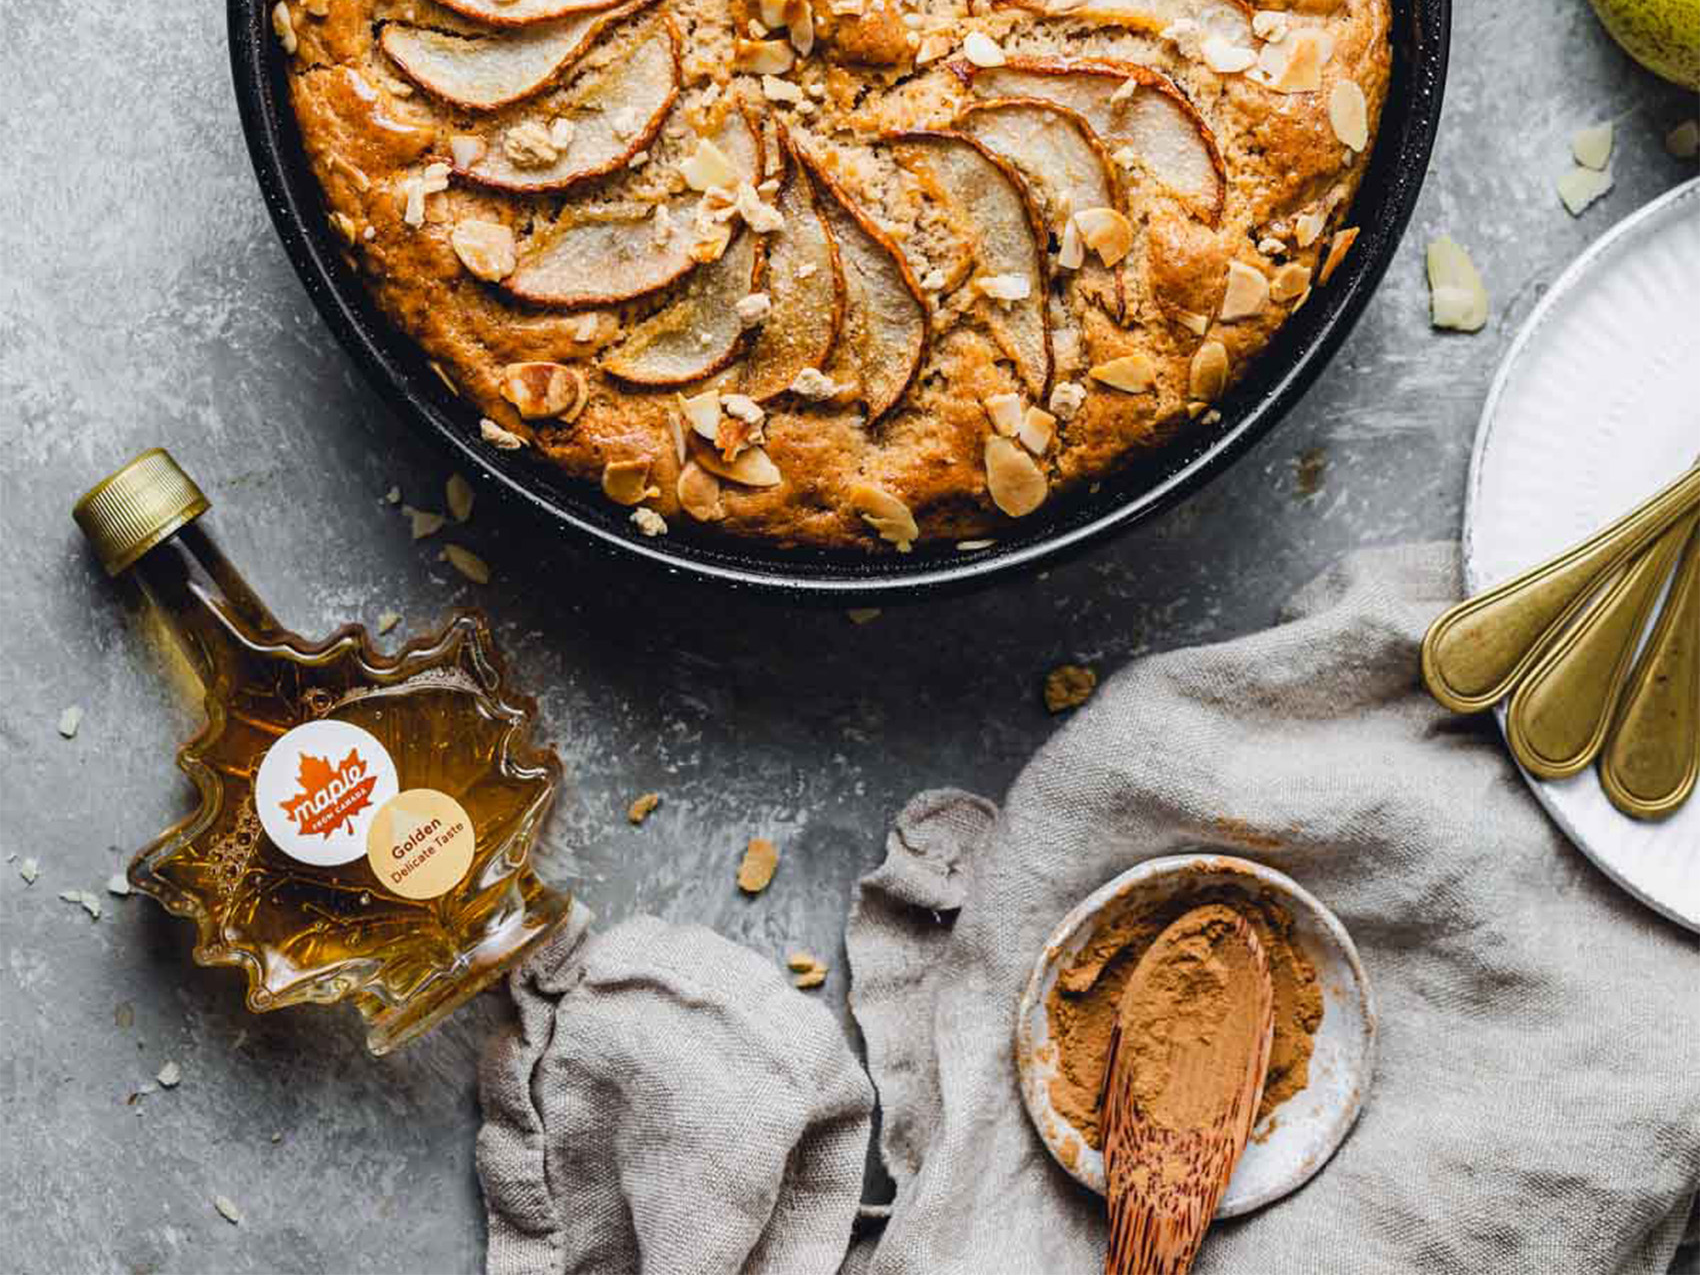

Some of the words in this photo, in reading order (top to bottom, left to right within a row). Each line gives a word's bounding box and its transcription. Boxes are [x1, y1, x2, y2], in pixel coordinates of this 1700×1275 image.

[294, 765, 365, 822] maple
[312, 811, 334, 830] FROM
[335, 788, 369, 814] CANADA
[391, 817, 442, 860] Golden
[391, 846, 436, 884] Delicate
[435, 822, 465, 848] Taste
